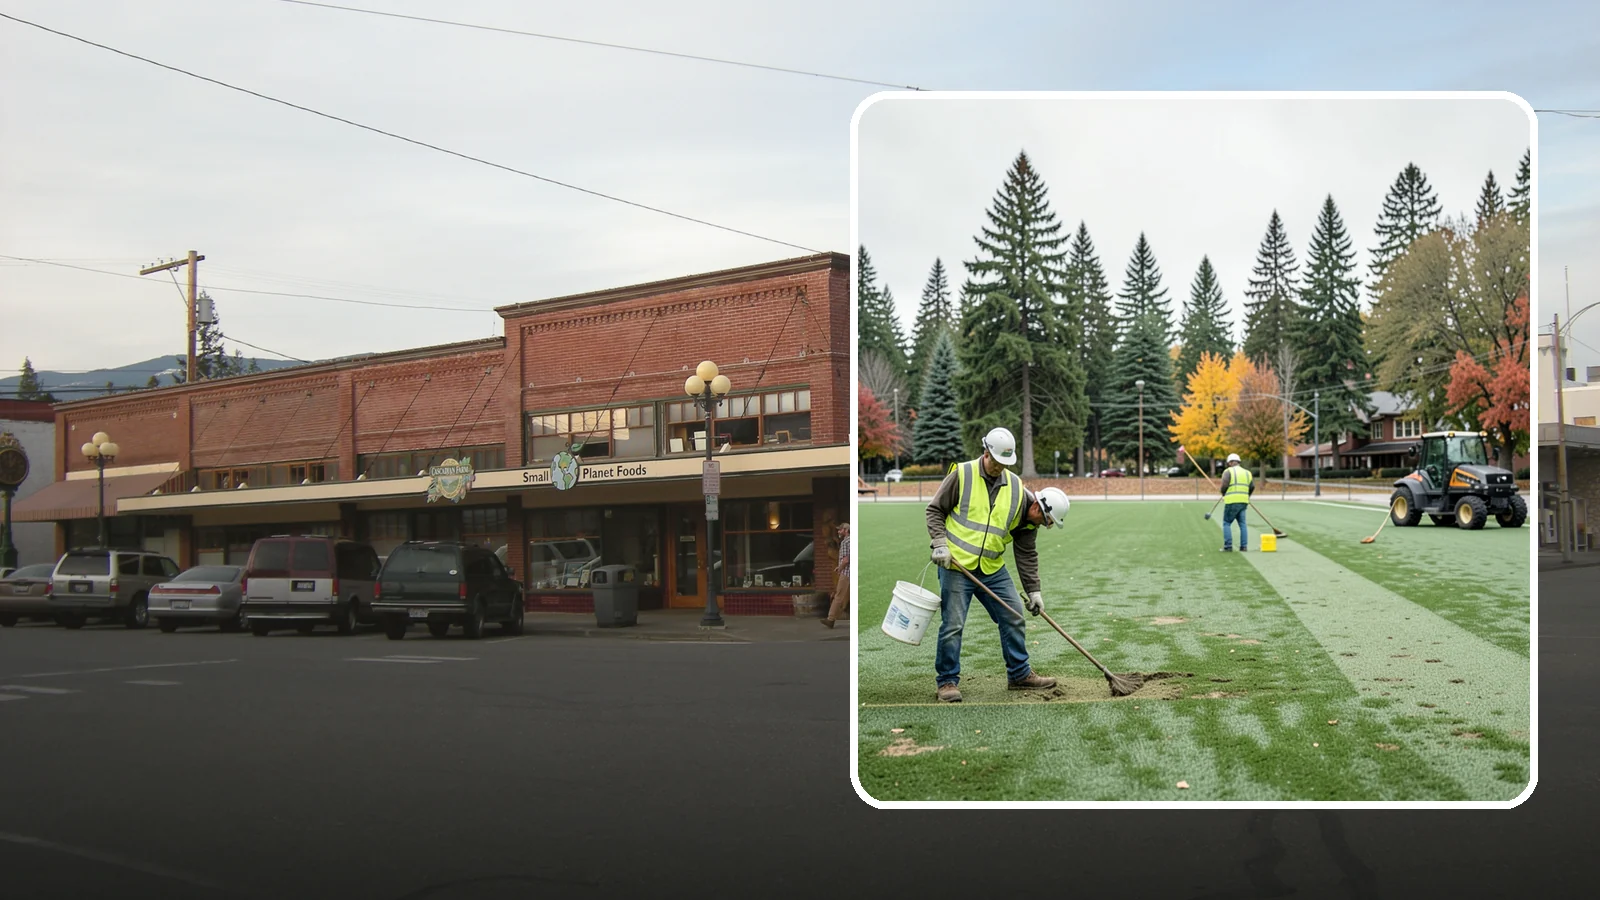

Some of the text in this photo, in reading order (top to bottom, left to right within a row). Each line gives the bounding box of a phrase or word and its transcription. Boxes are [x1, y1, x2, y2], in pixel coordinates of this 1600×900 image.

[523, 464, 647, 483] Small Planet Foods
